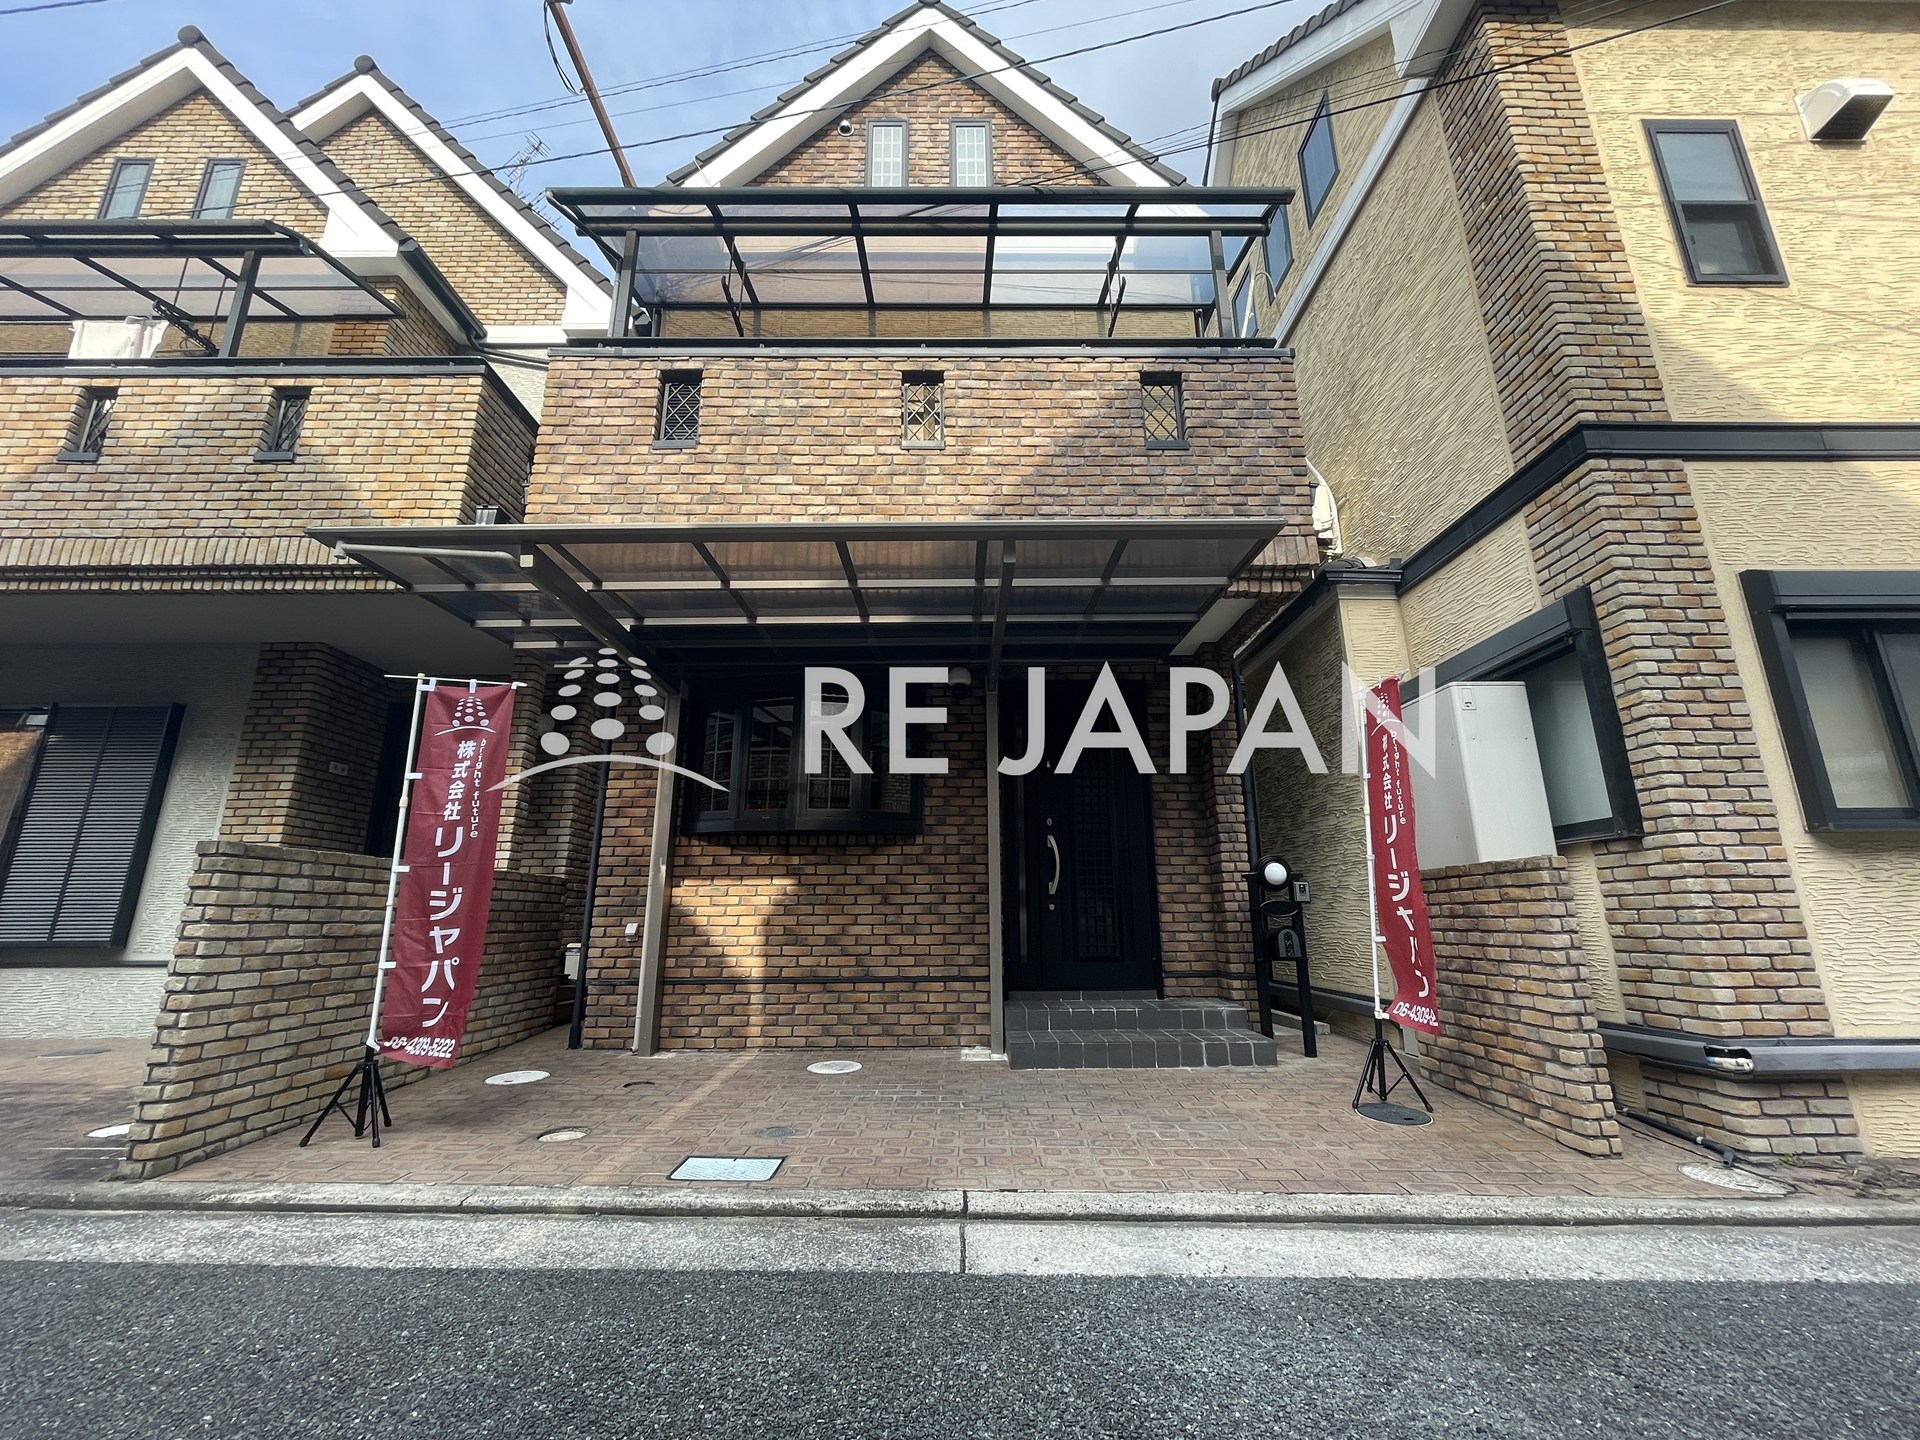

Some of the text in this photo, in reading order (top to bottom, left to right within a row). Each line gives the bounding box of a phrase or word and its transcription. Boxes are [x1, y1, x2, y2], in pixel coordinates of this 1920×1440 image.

[470, 738, 487, 838] bright future
[1390, 729, 1407, 825] bright future
